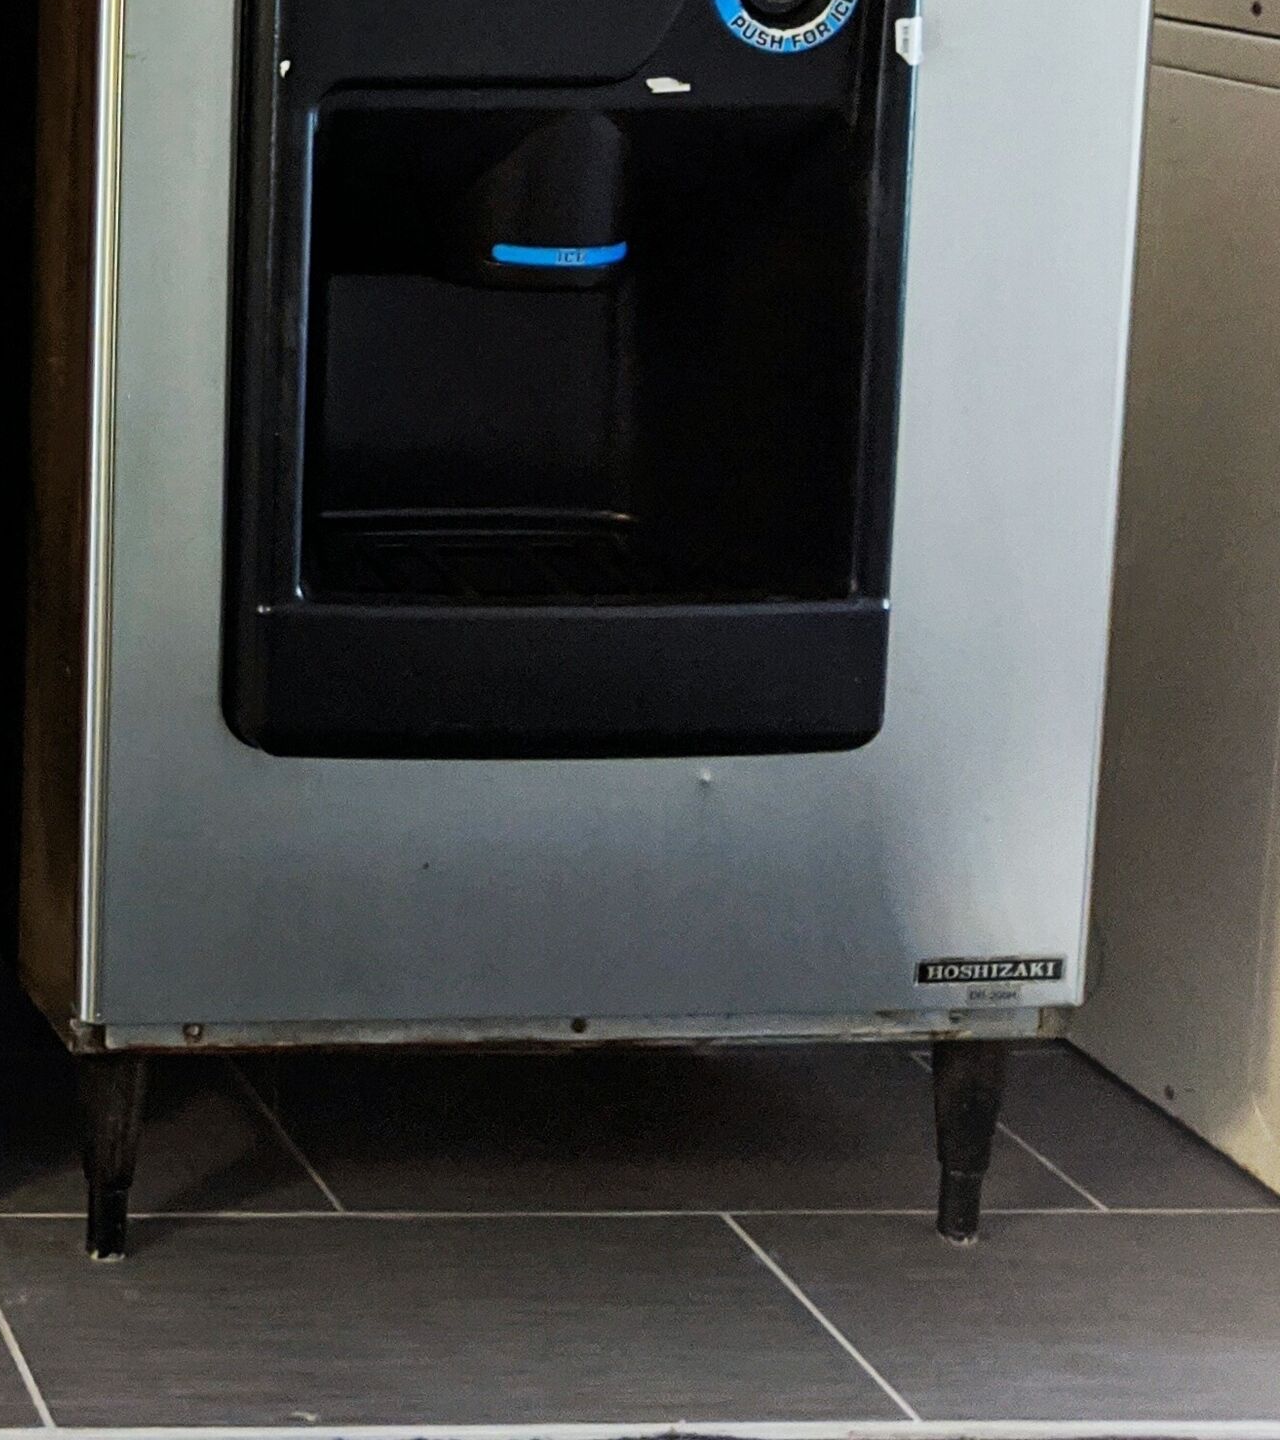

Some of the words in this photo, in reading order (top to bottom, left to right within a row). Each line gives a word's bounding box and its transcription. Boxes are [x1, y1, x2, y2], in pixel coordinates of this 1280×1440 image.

[730, 15, 784, 49] PUSH
[792, 25, 833, 49] FOR
[926, 961, 1056, 980] HOSHIZAKI
